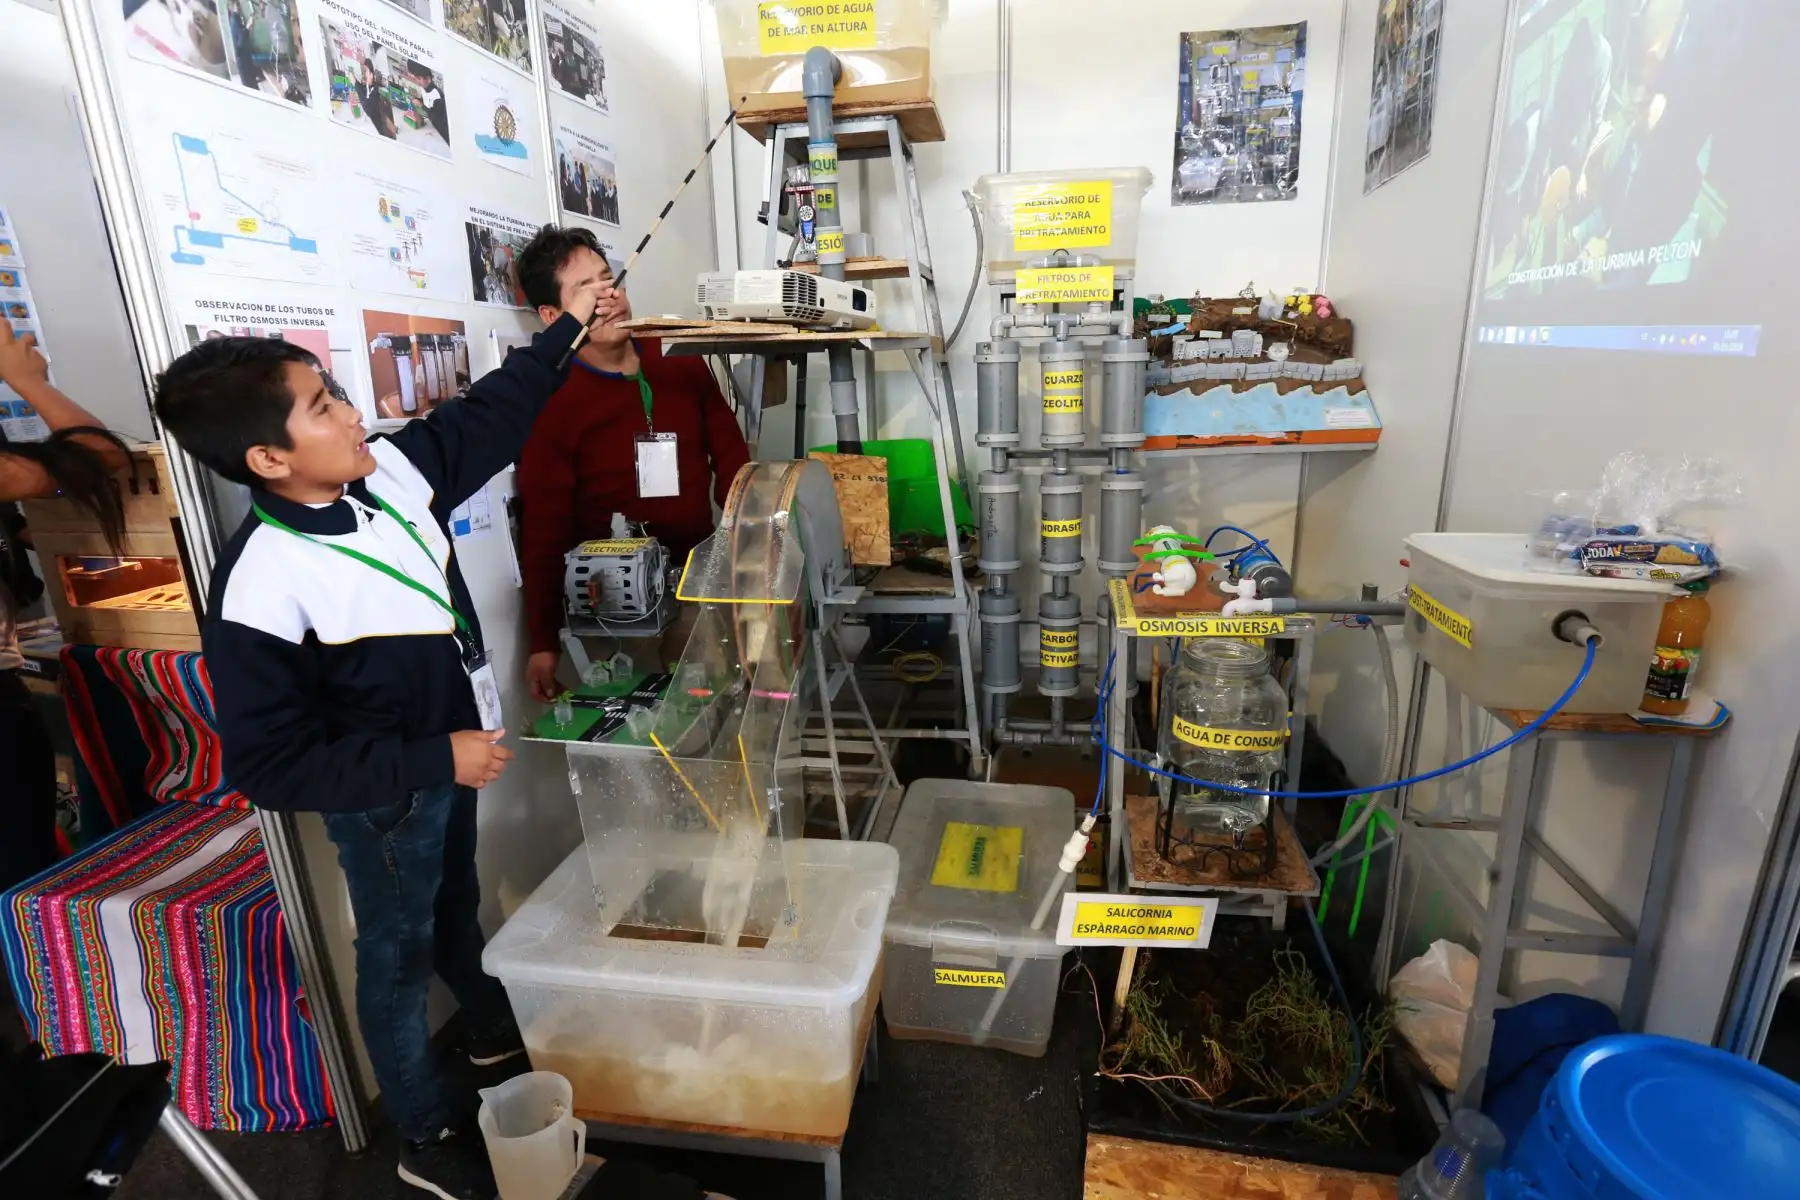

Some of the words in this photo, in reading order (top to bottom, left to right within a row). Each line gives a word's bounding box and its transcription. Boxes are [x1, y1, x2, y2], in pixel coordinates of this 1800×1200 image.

[827, 4, 840, 15] DE
[843, 2, 874, 13] AGUA
[767, 27, 780, 38] DE
[811, 24, 824, 34] EN
[827, 21, 868, 32] ALTURA
[344, 20, 360, 32] USO
[361, 27, 376, 40] DEL
[376, 35, 397, 51] PANEL
[399, 46, 419, 61] SOLAR
[381, 27, 408, 45] SISTEMA
[409, 41, 426, 53] PARA
[817, 194, 832, 203] DE
[1088, 194, 1100, 203] DE
[1064, 211, 1091, 220] PARA
[818, 236, 844, 250] ESIÓ
[1508, 262, 1564, 284] CONSTRUCCIÓN
[1566, 260, 1579, 276] DE
[1581, 258, 1595, 274] LA
[1597, 249, 1644, 271] TURBINA
[1649, 239, 1702, 264] PELTON
[1037, 274, 1076, 284] FILTROS
[1080, 273, 1092, 283] DE
[1020, 289, 1110, 299] RETRATAMIENTO
[195, 300, 263, 312] OBSERVACION
[265, 304, 276, 312] DE
[278, 305, 295, 313] LOS
[297, 306, 323, 315] TUBOS
[325, 308, 335, 316] DE
[214, 314, 248, 323] FILTRO
[250, 316, 288, 325] OSMOSIS
[291, 318, 325, 327] INVERSA
[1044, 374, 1083, 385] CUARZO
[1041, 522, 1082, 532] NDRASIT
[1139, 620, 1209, 633] OSMOSIS
[1215, 621, 1280, 634] INVERSA
[1176, 722, 1209, 742] AGUA
[1213, 733, 1231, 744] DE
[1234, 736, 1282, 747] CONSUM
[1106, 907, 1173, 919] SALICORNIA
[1076, 922, 1145, 935] ESPÀRRAGO
[1147, 926, 1195, 936] MARINO
[935, 972, 1005, 985] SALMUERA
